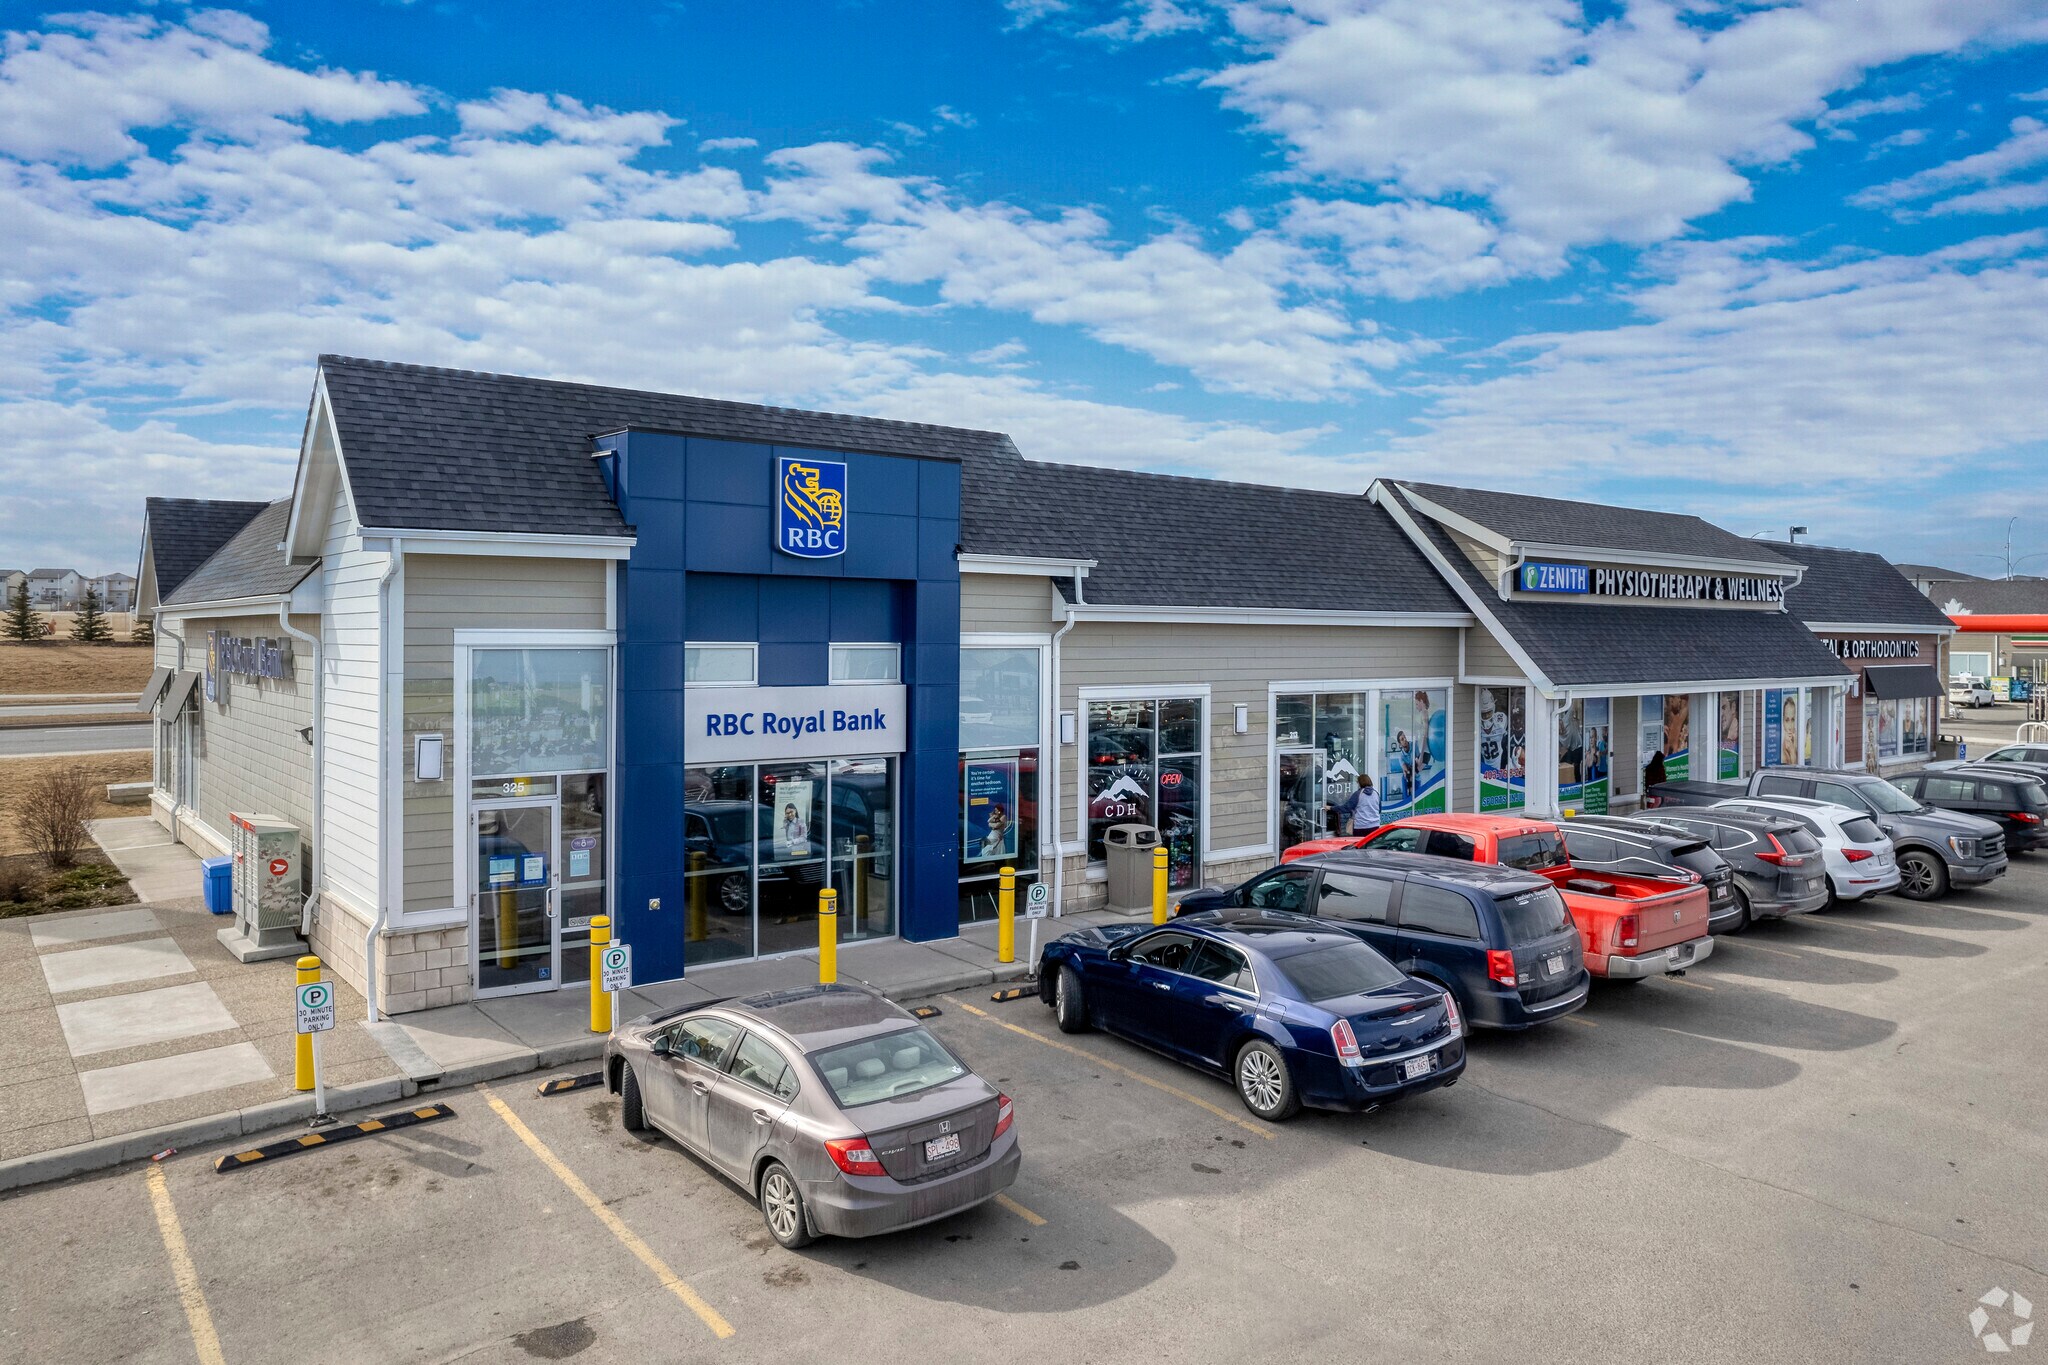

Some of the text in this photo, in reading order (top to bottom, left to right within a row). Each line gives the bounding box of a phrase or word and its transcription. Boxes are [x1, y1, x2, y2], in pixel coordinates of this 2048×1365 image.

[788, 527, 839, 549] RBC
[1539, 566, 1785, 602] ZENITH PHYSIOTHERAPY & WELLNESS
[1843, 639, 1850, 658] &
[1852, 639, 1920, 658] ORTHODONTICS
[706, 707, 887, 740] RBC Royal Bank
[1161, 773, 1182, 785] OPEN
[502, 782, 525, 793] 325
[1327, 782, 1352, 795] CDH
[1482, 795, 1507, 807] SPORTS
[1104, 803, 1137, 818] CDH
[1035, 889, 1042, 898] P
[612, 953, 621, 966] P
[611, 966, 629, 975] MINUTE
[606, 974, 627, 983] PARKING
[610, 982, 623, 990] ONLY
[310, 990, 322, 1004] P
[298, 1005, 333, 1017] 30 MINUTE
[303, 1013, 330, 1024] PARKING
[307, 1022, 325, 1031] ONLY
[881, 1146, 906, 1155] CIVIC
